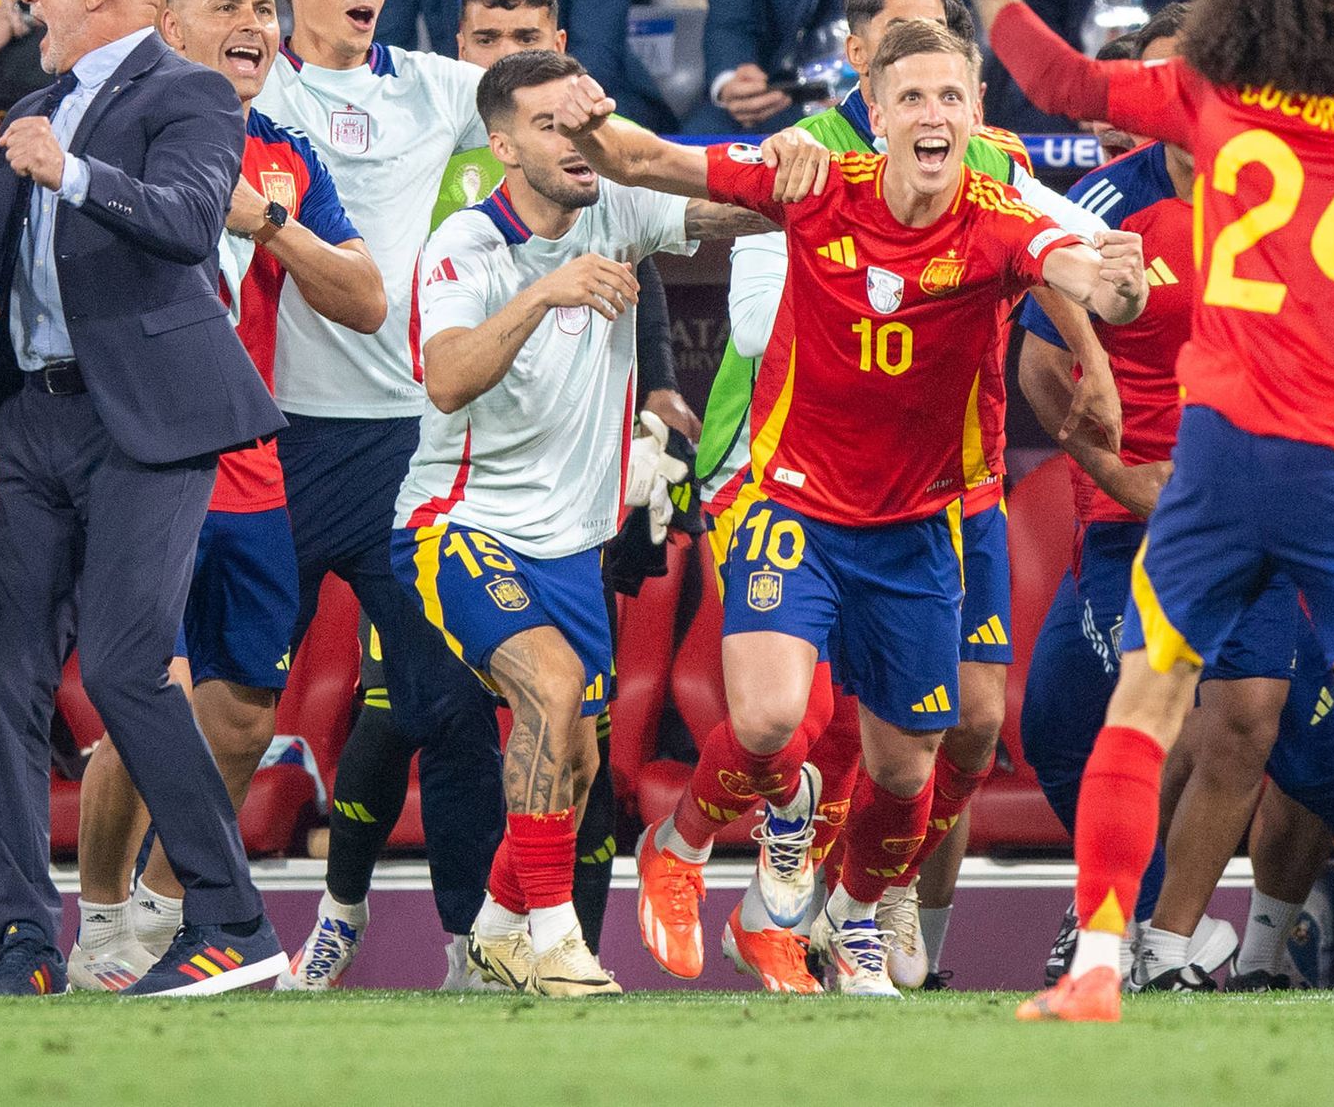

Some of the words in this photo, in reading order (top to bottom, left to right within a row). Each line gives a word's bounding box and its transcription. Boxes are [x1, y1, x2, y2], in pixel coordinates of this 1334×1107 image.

[851, 317, 914, 376] 10
[443, 530, 517, 579] 15
[745, 508, 806, 571] 10
